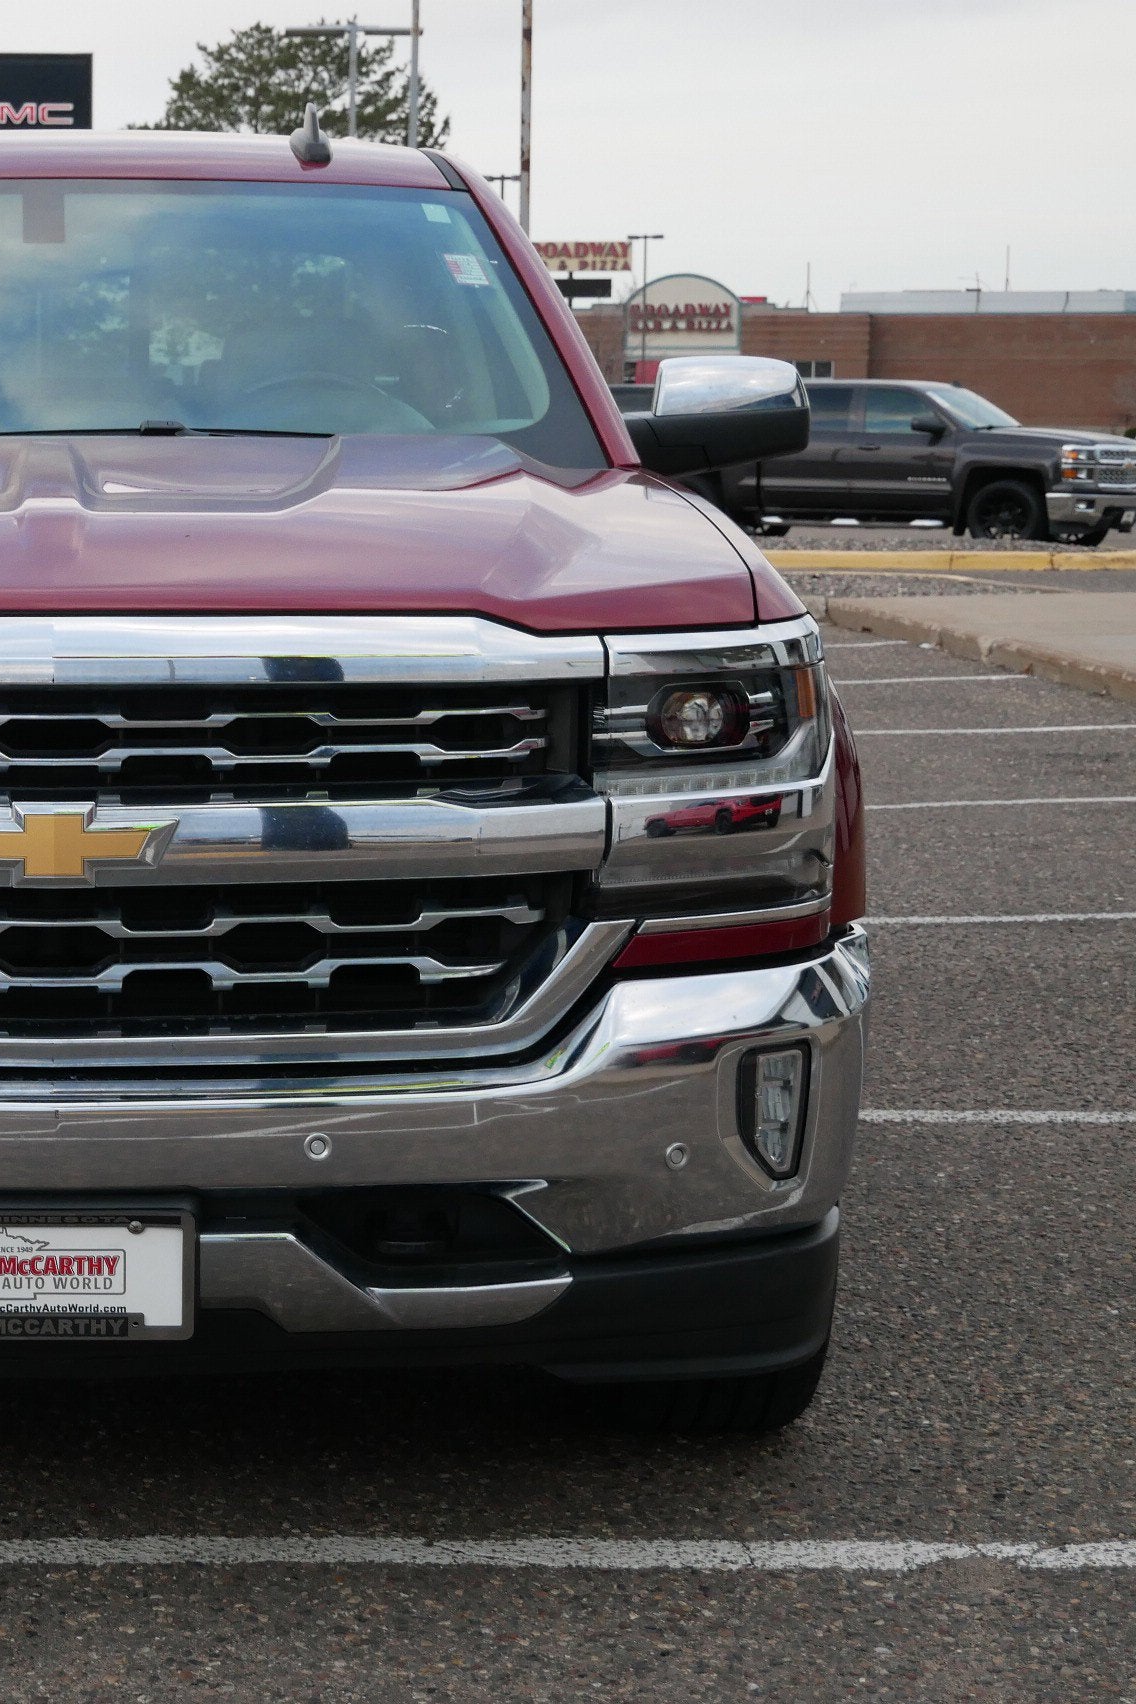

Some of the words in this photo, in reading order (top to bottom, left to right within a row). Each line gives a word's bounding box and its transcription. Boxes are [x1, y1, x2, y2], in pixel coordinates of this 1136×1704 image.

[531, 242, 630, 258] ROADWAY
[578, 260, 631, 271] PIZZA
[629, 303, 732, 318] BROADWAY
[1, 1277, 45, 1290] AUTO
[53, 1277, 113, 1290] WORLD
